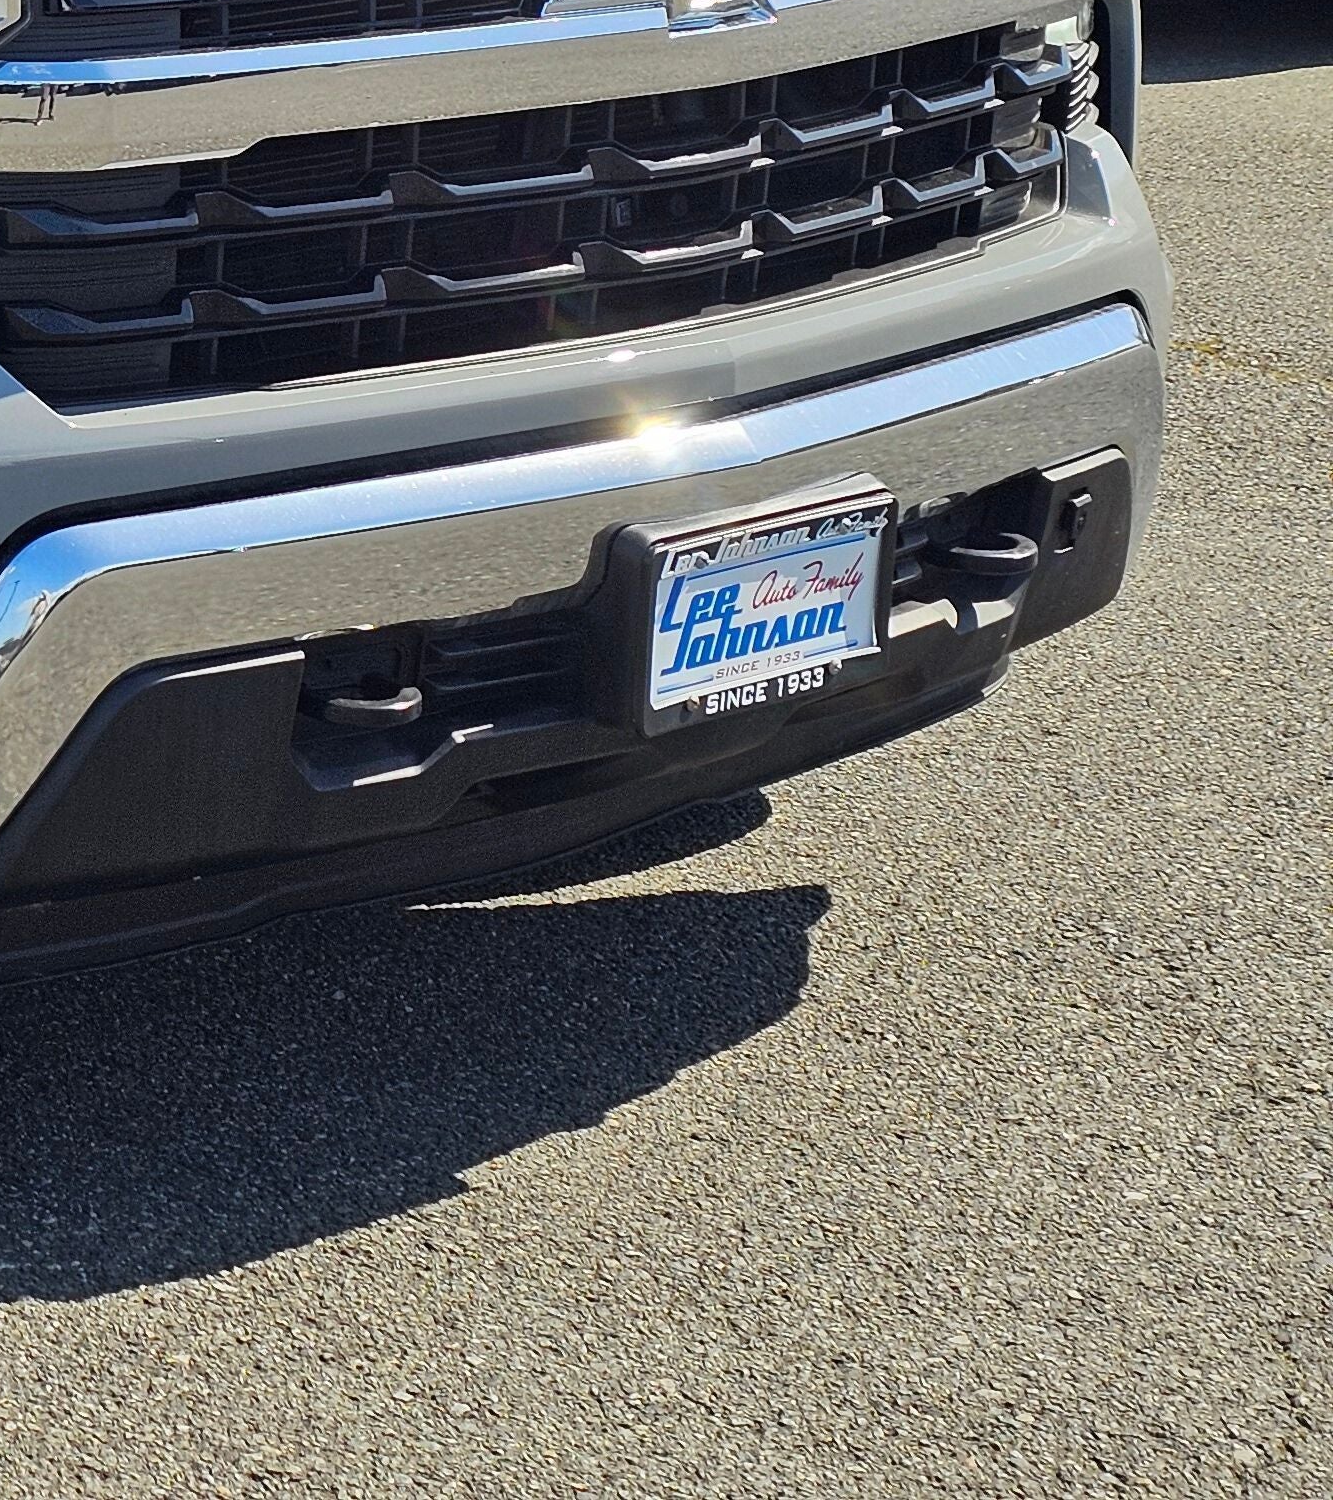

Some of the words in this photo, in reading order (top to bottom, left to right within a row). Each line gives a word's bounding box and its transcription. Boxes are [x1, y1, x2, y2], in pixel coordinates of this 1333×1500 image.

[709, 526, 811, 565] Johnson
[816, 517, 853, 541] Au
[658, 576, 743, 634] Lee
[752, 570, 798, 610] Auto
[802, 551, 865, 601] Family
[659, 600, 847, 677] Johnson
[715, 659, 760, 679] SINCE
[766, 650, 801, 668] 1933
[705, 681, 769, 716] SINCE
[777, 666, 825, 698] 1933
